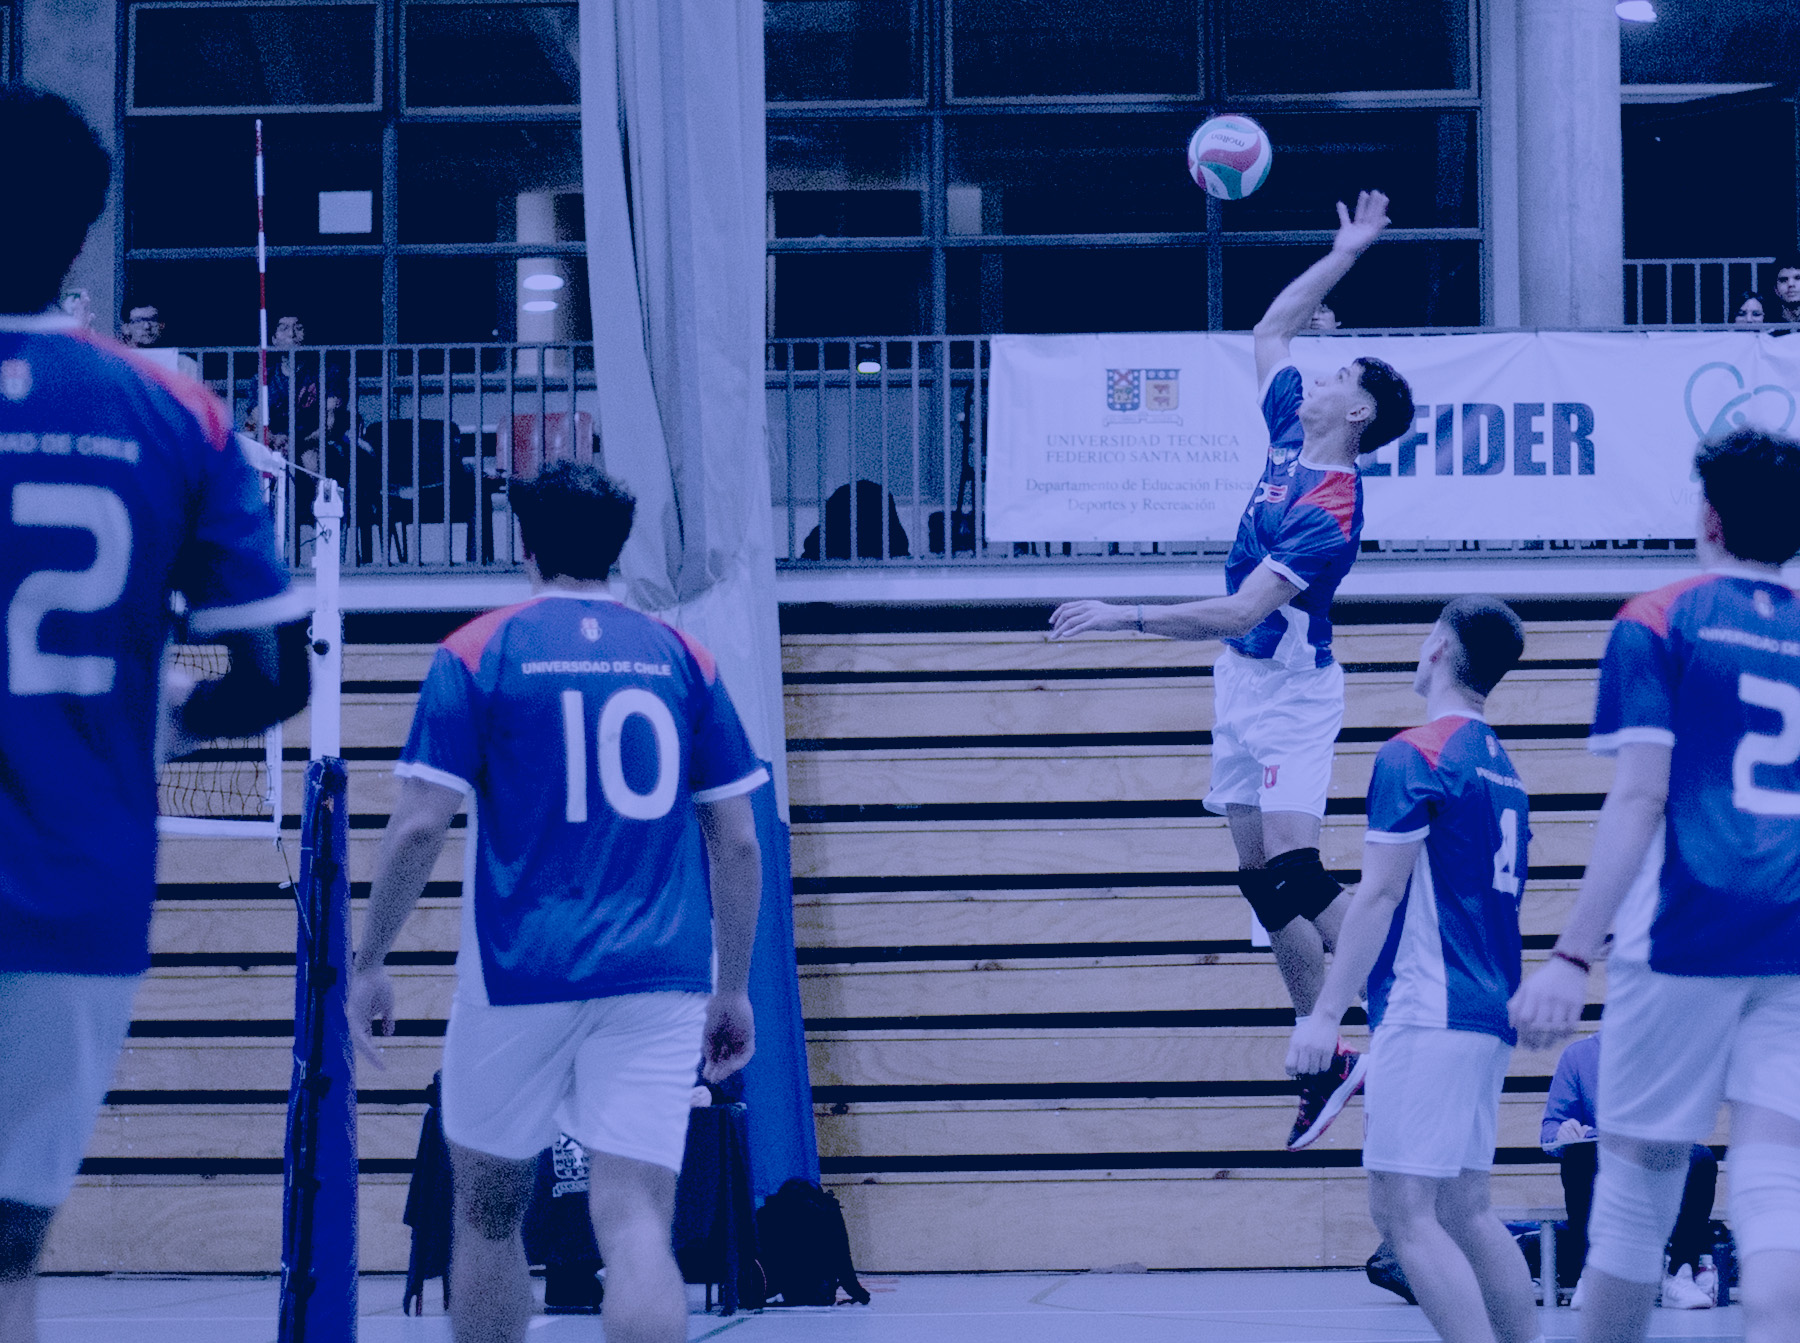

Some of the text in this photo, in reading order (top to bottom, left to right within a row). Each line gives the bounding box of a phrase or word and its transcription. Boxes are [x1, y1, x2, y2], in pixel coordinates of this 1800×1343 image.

[1211, 133, 1245, 147] molten
[1046, 433, 1240, 447] UNIVERSIDAD TECNICA
[1046, 450, 1240, 463] FEDERICO SANTA MARIA
[1026, 478, 1254, 493] Departamento de Educación Física
[1068, 497, 1216, 514] Deportes y Recreación
[7, 482, 133, 696] 2
[521, 660, 673, 676] UNIVERSIDAD DE CHILE
[1732, 672, 1800, 815] 2
[562, 687, 681, 823] 10
